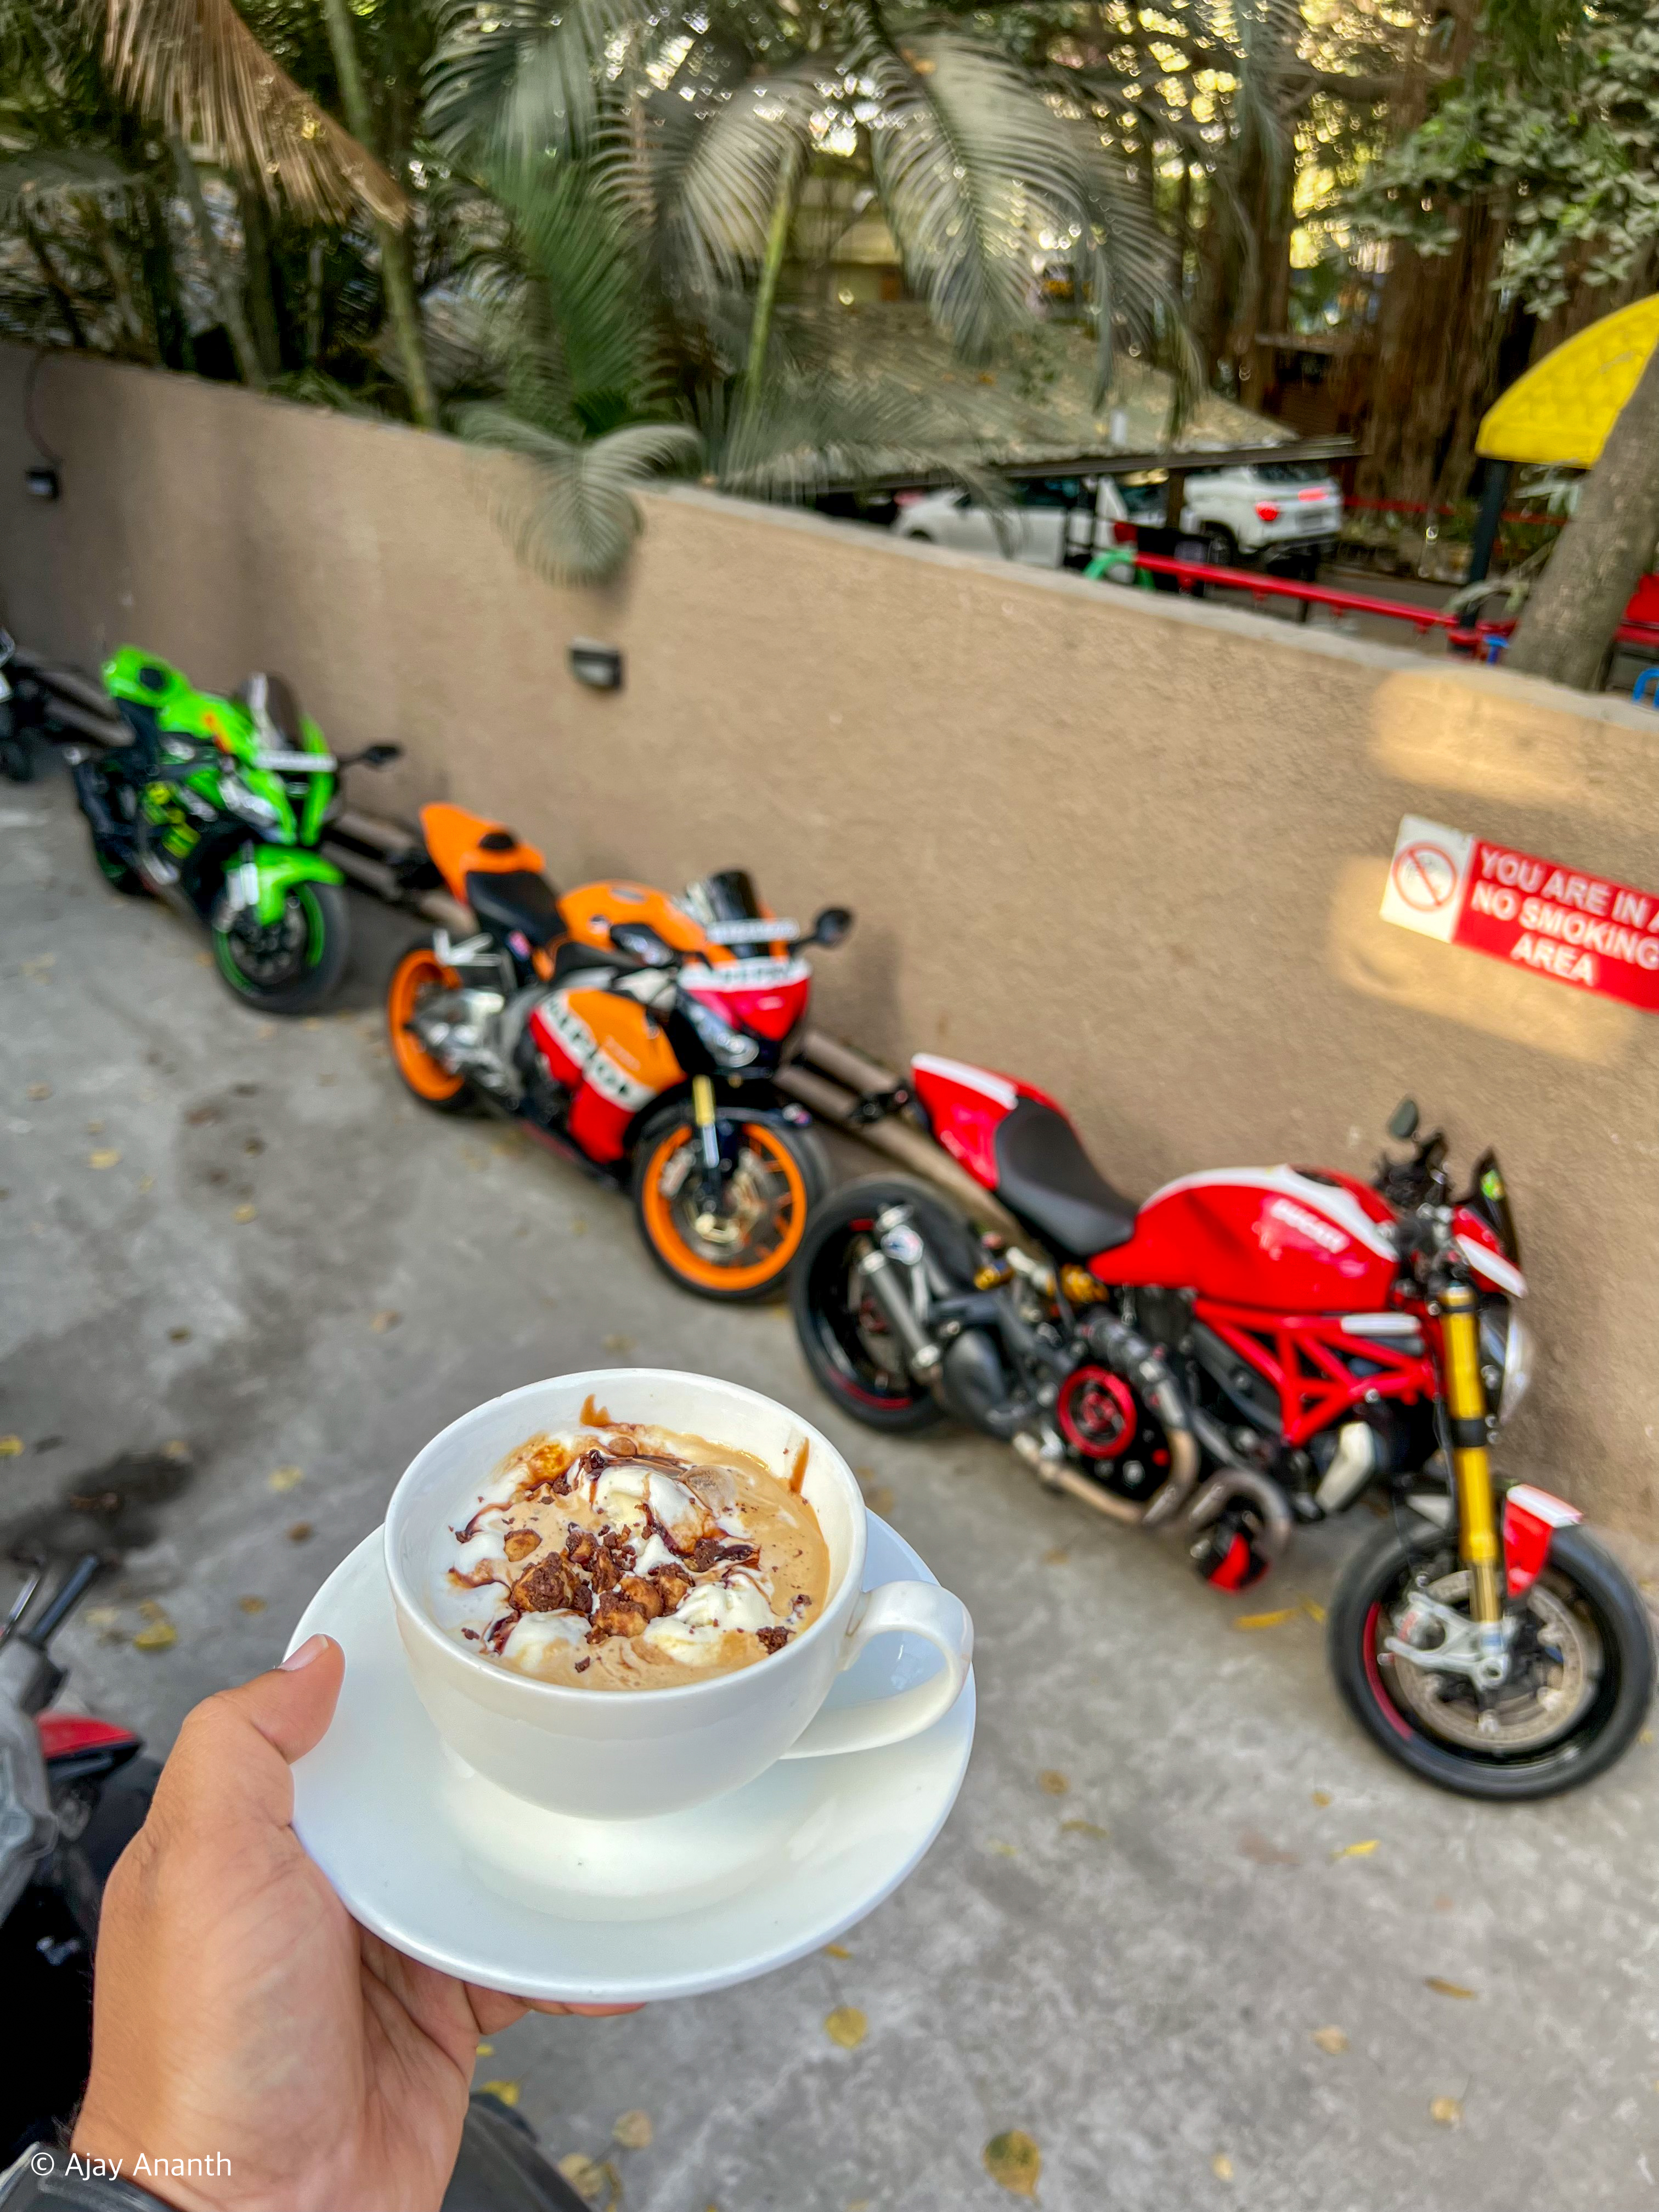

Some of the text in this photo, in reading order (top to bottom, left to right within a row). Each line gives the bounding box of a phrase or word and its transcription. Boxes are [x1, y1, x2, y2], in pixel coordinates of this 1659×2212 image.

[1471, 881, 1519, 920] NO
[1520, 896, 1659, 970] SMOKING
[1481, 848, 1543, 893] YOU
[1542, 870, 1610, 916] ARE
[1612, 890, 1648, 929] IN
[1510, 933, 1595, 986] AREA
